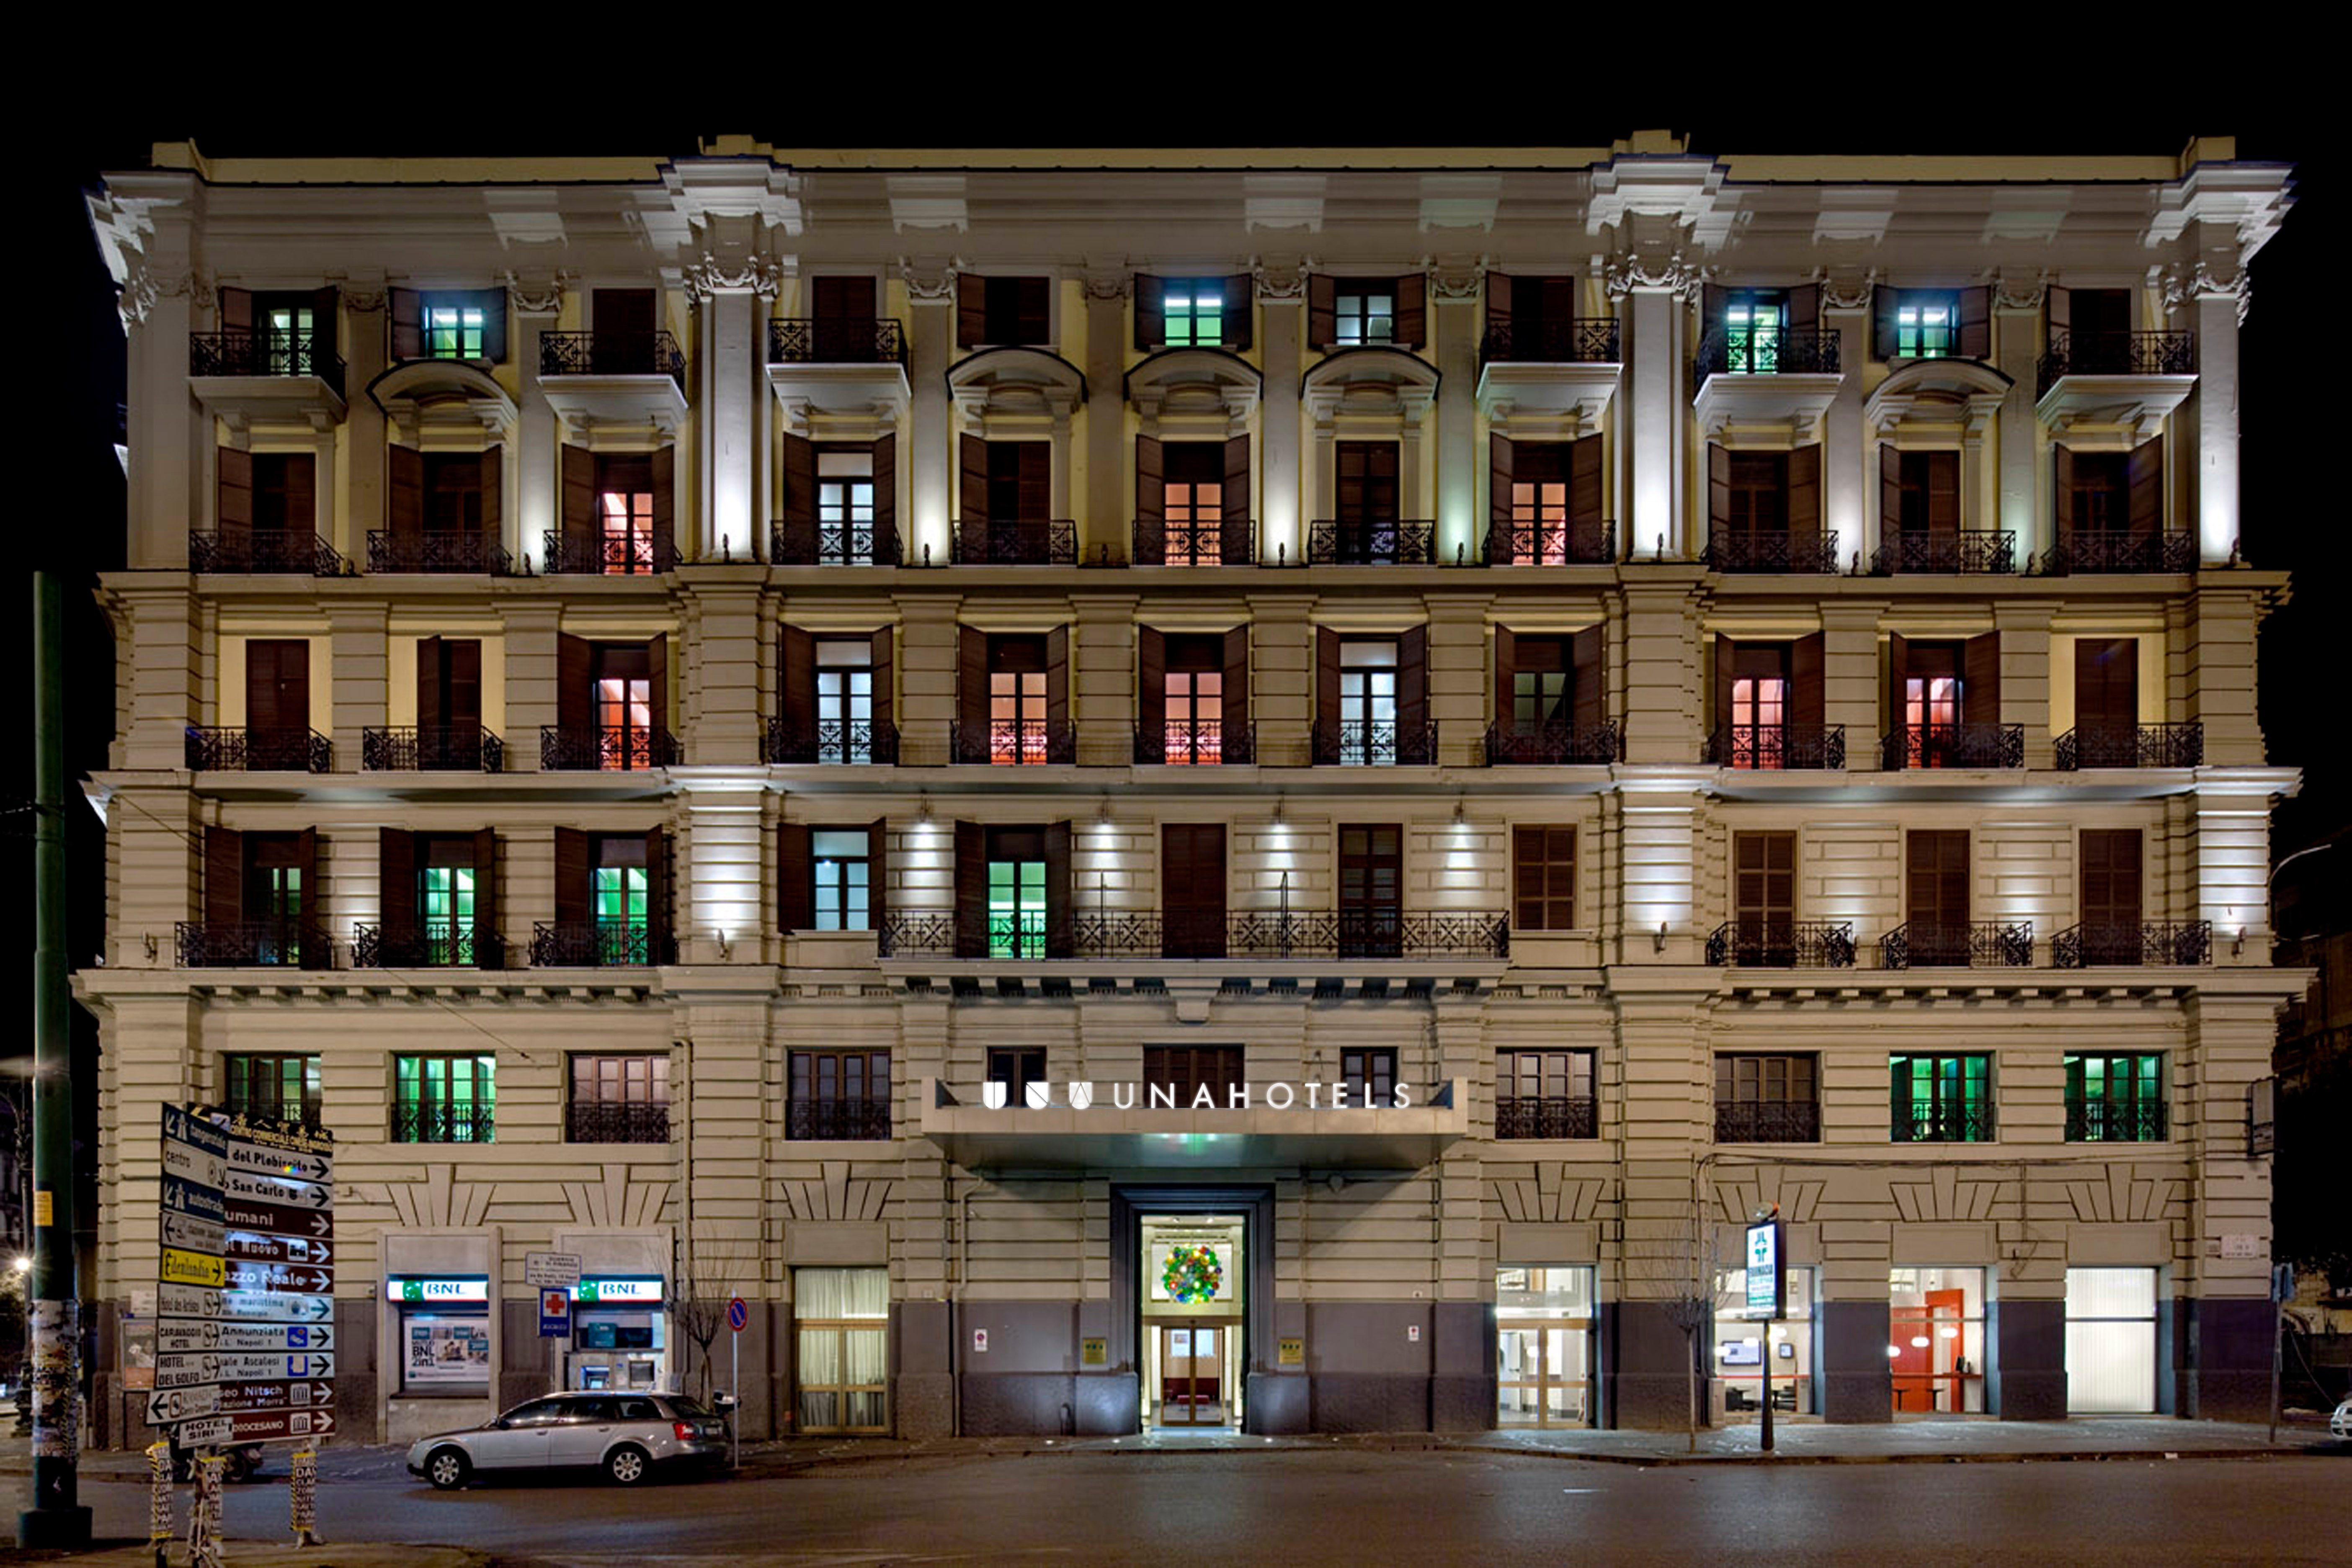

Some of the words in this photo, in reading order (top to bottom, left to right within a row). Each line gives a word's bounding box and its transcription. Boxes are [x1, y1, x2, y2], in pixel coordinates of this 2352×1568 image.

[1114, 1082, 1411, 1109] UNAHOTELS
[233, 1148, 250, 1163] del
[232, 1179, 253, 1192] San
[255, 1183, 285, 1197] Carlo
[241, 1240, 279, 1255] Nuovo
[261, 1270, 305, 1286] Reale
[427, 1283, 467, 1295] BNL
[603, 1283, 642, 1295] BNL
[222, 1326, 285, 1336] Annunziata
[412, 1345, 435, 1357] BNL
[160, 1356, 184, 1368] HOTEL
[158, 1373, 173, 1385] DEL
[175, 1372, 200, 1383] GOLFO
[244, 1385, 283, 1396] Nitsch
[186, 1419, 227, 1432] HOTEL
[188, 1429, 214, 1439] SIRI
